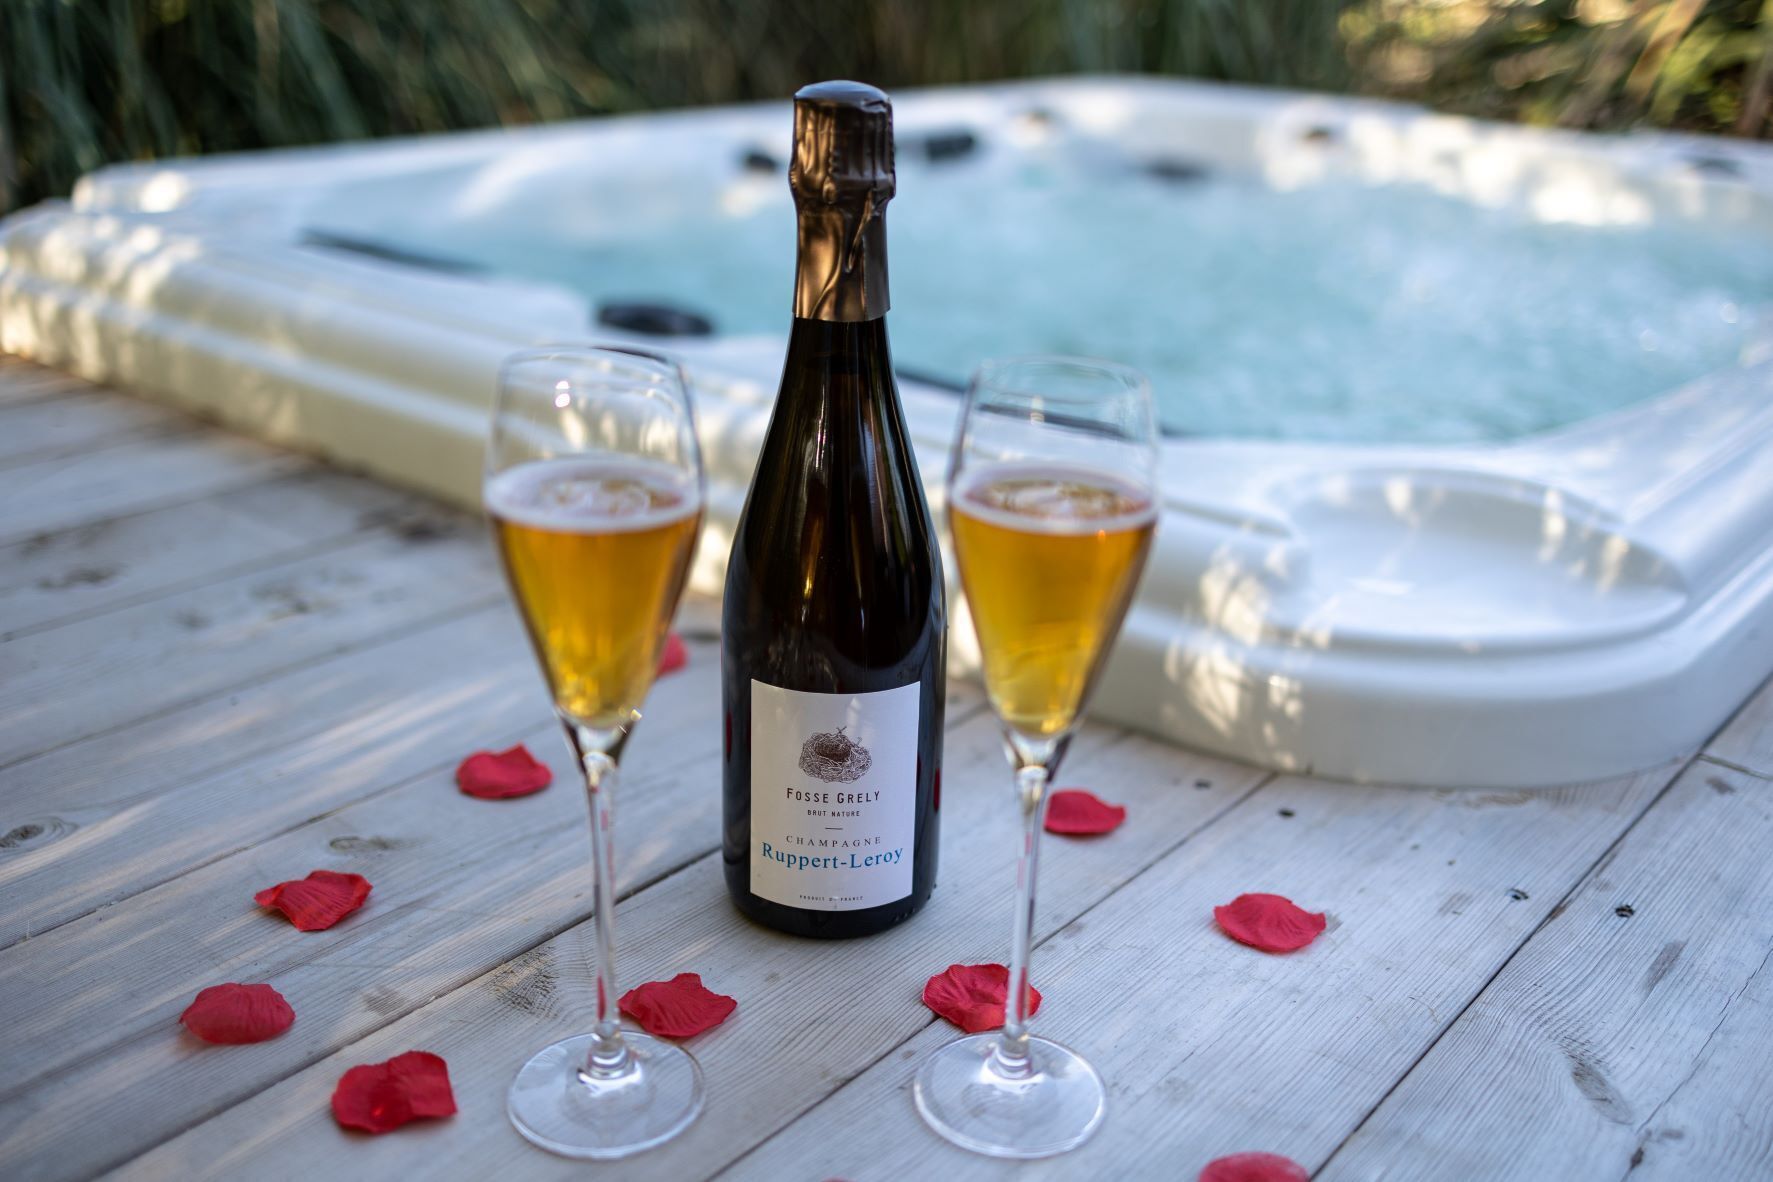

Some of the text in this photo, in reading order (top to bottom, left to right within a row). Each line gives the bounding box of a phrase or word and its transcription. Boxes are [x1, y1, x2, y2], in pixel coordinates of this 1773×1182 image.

[787, 787, 880, 804] FOSSE GRELY
[807, 809, 827, 817] BRUT
[786, 835, 881, 848] CHAMPAGNE
[761, 842, 904, 871] Ruppert-Leroy
